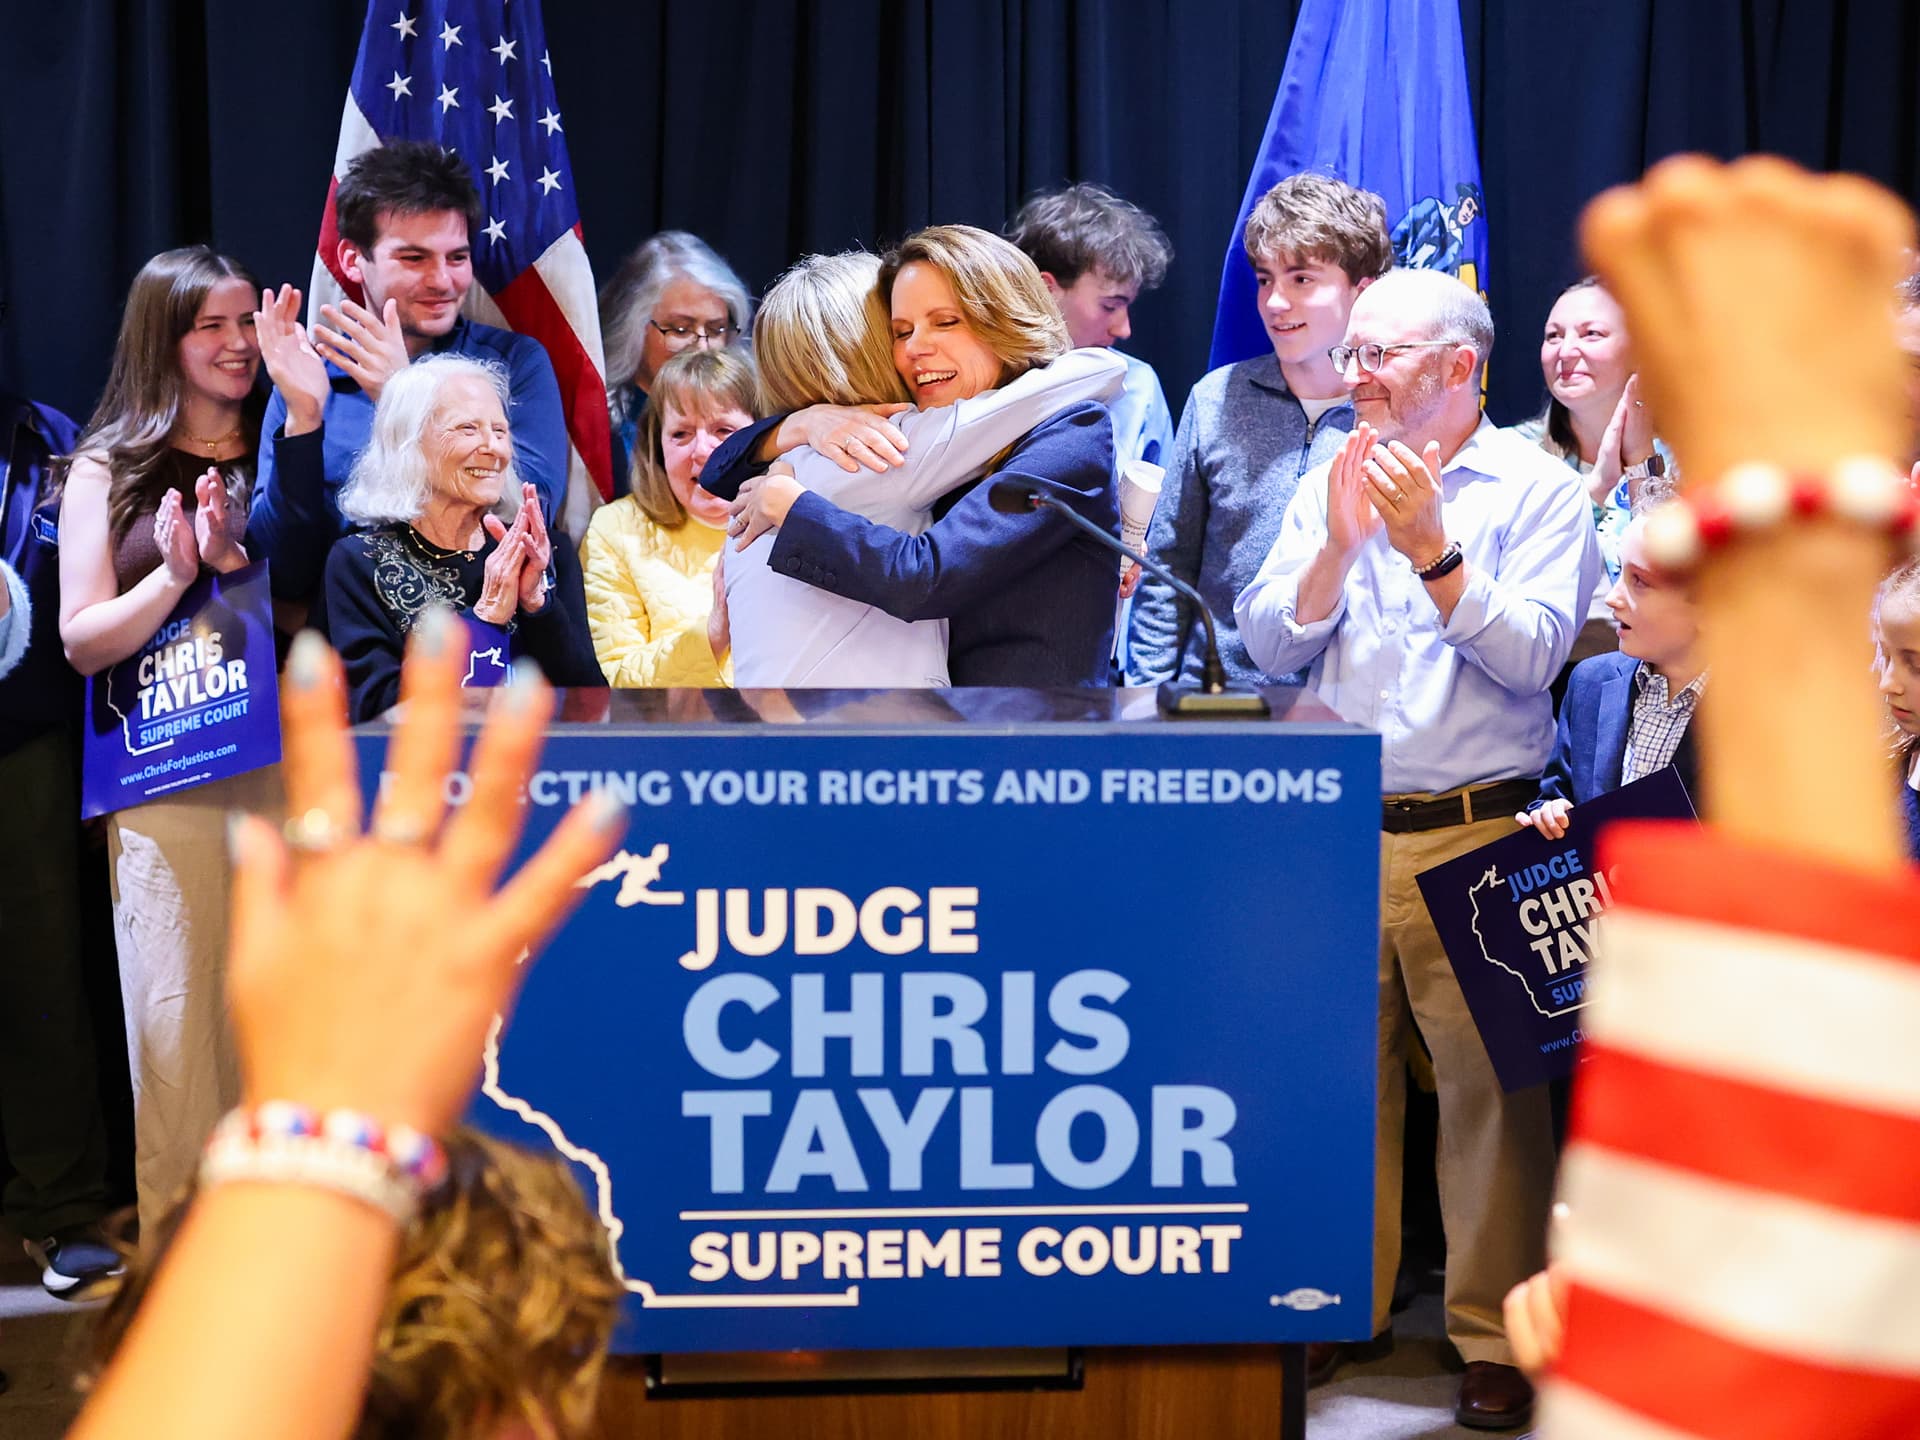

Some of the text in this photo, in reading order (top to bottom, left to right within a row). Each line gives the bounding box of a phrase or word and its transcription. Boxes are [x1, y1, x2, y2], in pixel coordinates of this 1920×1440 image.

[138, 632, 223, 686] CHRIS
[144, 618, 192, 652] DGE
[137, 659, 248, 720] TAYLOR
[140, 698, 249, 746] SUPREME COURT
[120, 744, 237, 786] www.ChrisForJustice.com
[681, 769, 807, 805] YOUR
[819, 769, 984, 804] RIGHTS
[993, 769, 1091, 803] AND
[1102, 769, 1342, 803] FREEDOMS
[1507, 849, 1584, 902] JUDGE
[679, 886, 979, 970] JUDGE
[1529, 916, 1604, 975] TAY
[682, 969, 1131, 1080] CHRIS
[682, 1084, 1238, 1194] TAYLOR
[689, 1225, 1242, 1282] SUPREME COURT
